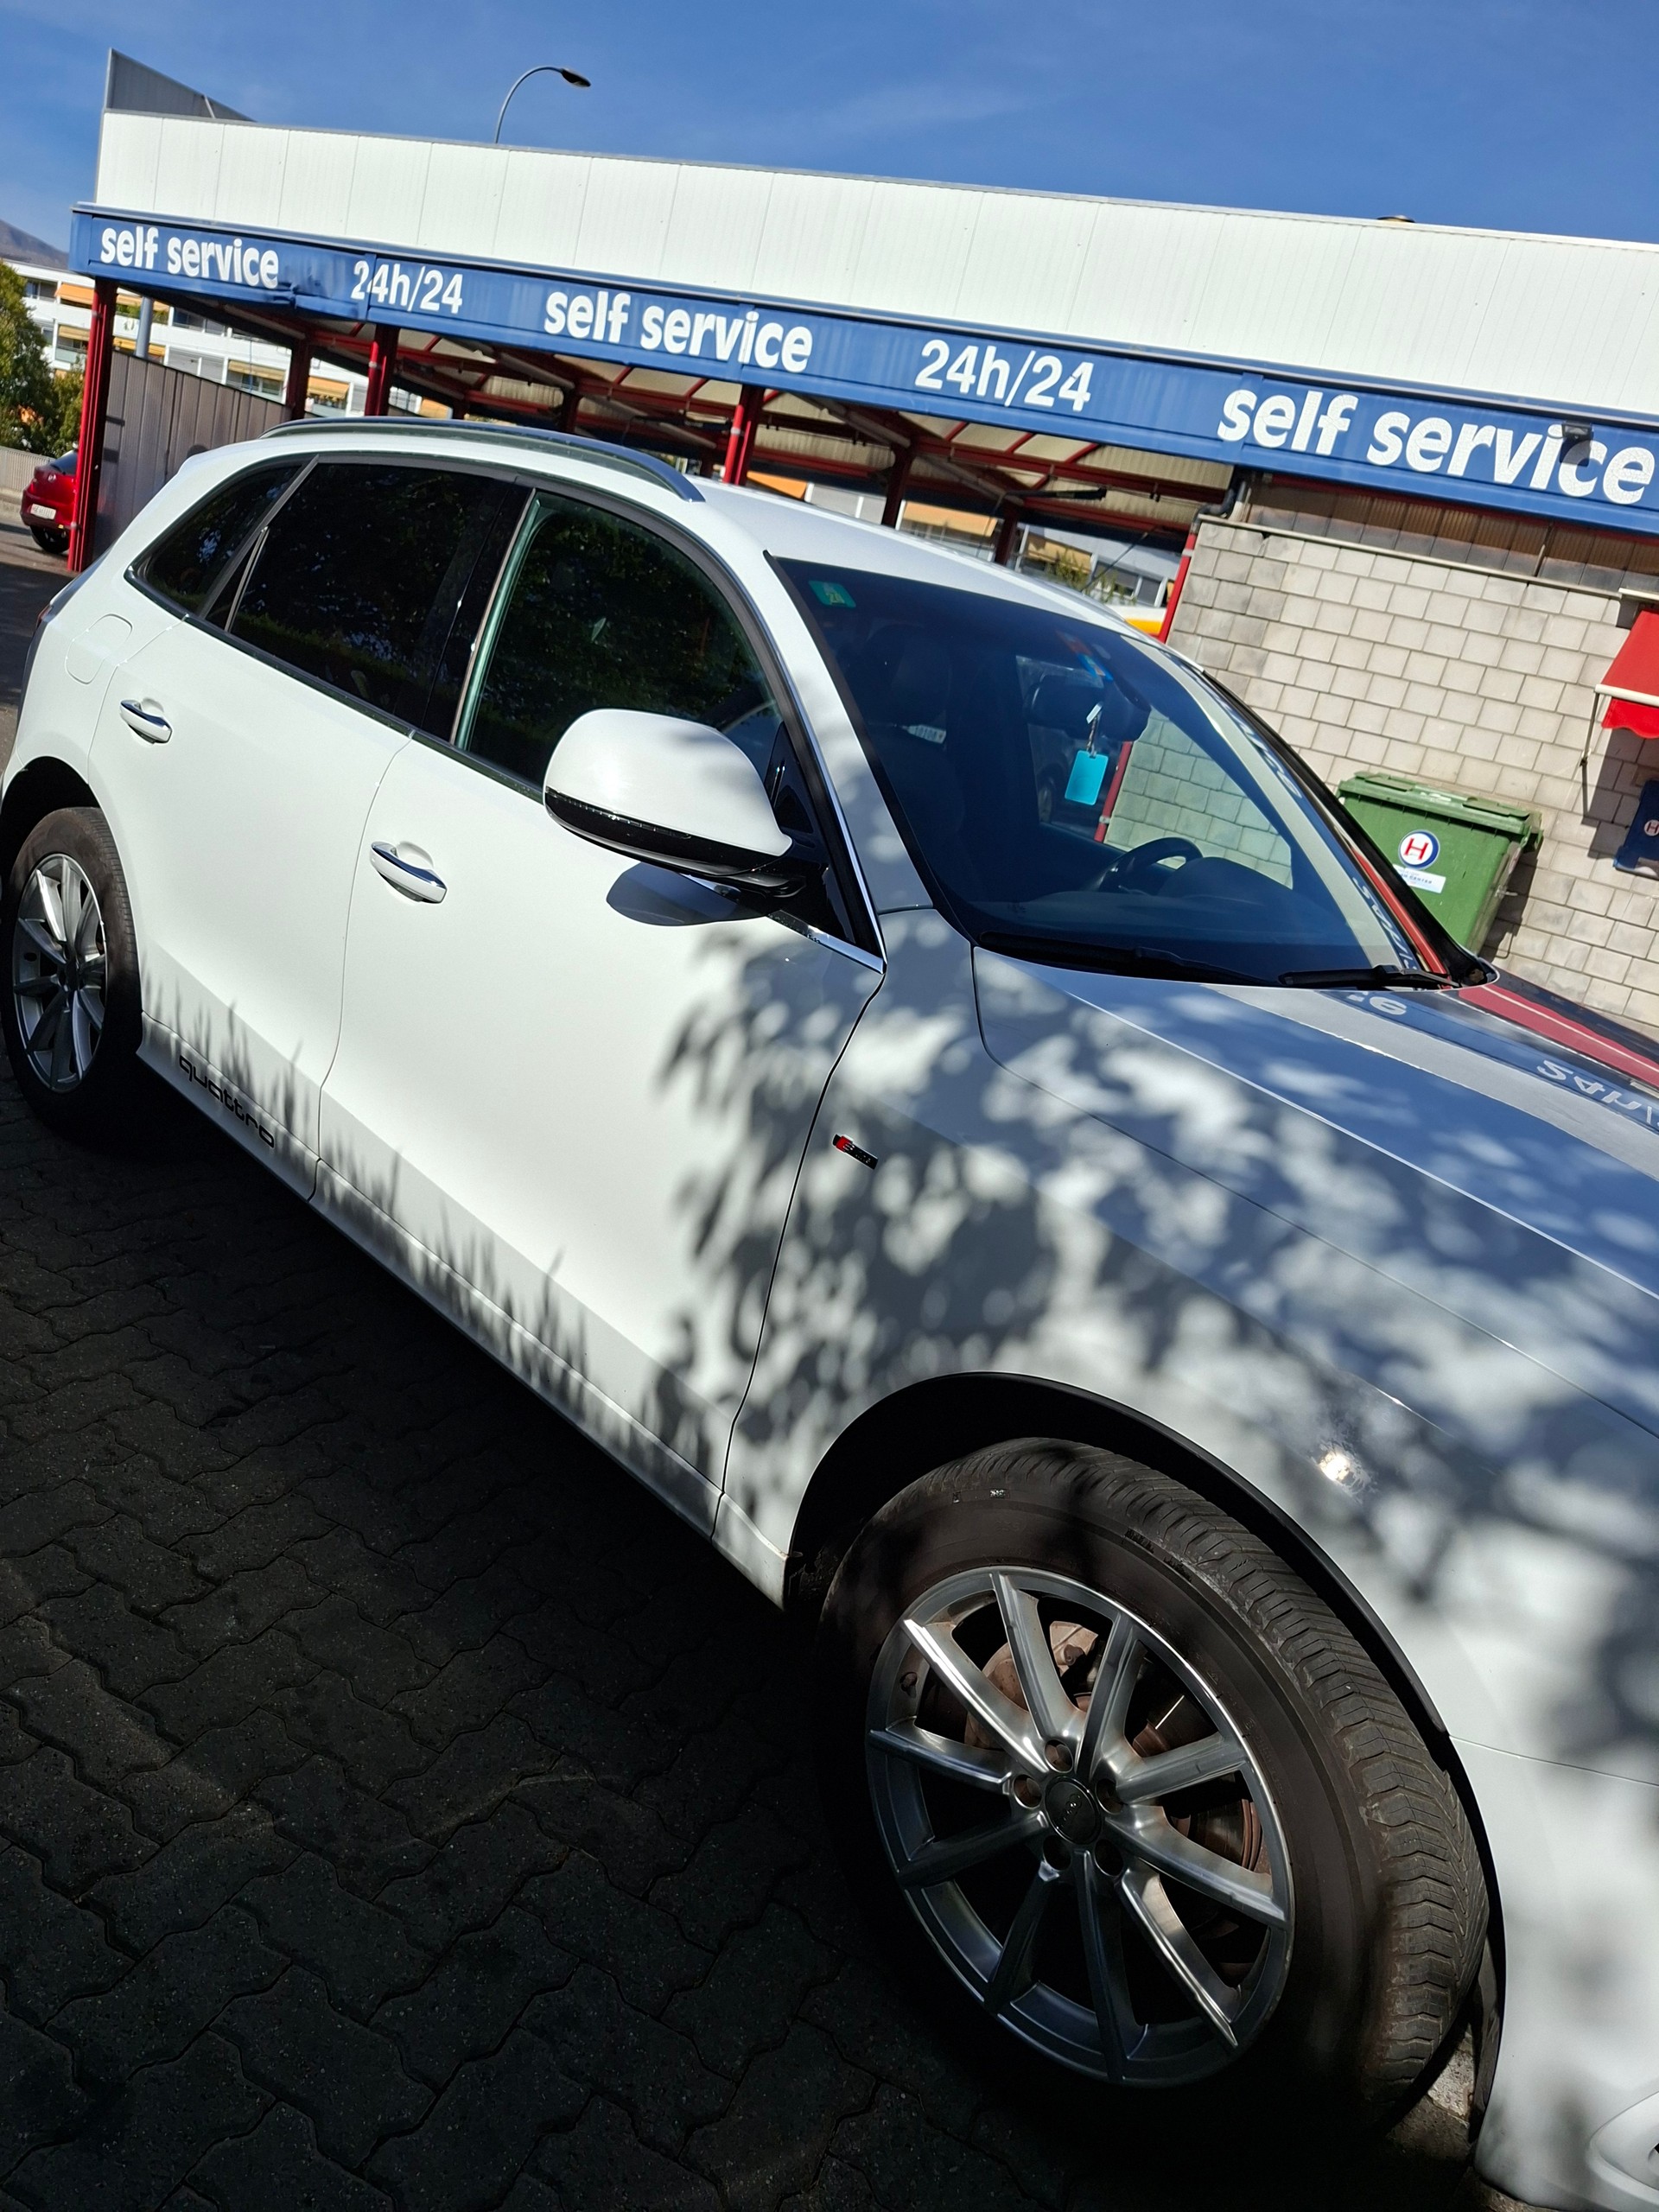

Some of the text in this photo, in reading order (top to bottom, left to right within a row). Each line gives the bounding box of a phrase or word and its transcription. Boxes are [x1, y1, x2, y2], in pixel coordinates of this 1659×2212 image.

[100, 226, 279, 289] self service
[350, 260, 463, 314] 24h/24
[543, 290, 813, 372] self service
[914, 340, 1095, 411] 24h/24
[1217, 389, 1656, 505] self service
[1403, 837, 1429, 861] H
[179, 1055, 275, 1148] quattro
